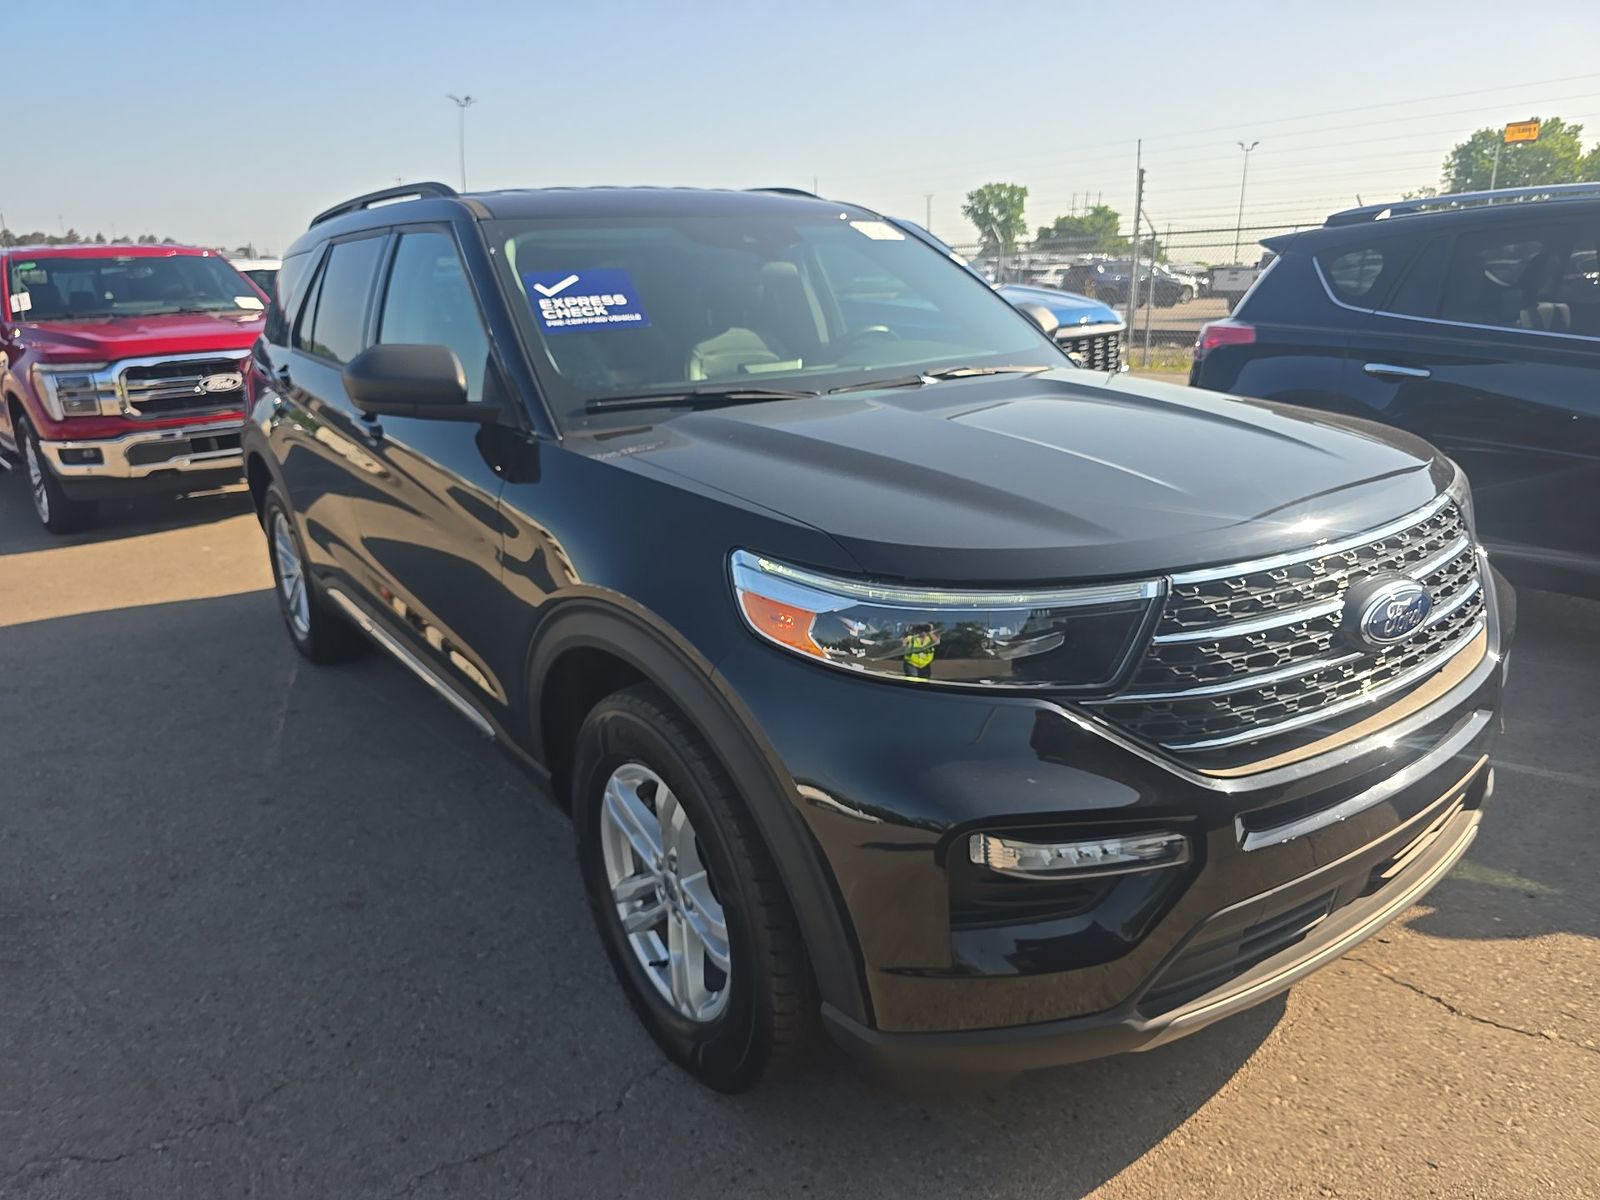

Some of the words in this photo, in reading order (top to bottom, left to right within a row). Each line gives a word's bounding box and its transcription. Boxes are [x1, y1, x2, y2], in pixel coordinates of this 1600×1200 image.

[539, 294, 627, 310] EXPRESS
[542, 306, 608, 319] CHECK
[1383, 597, 1423, 637] Ford
